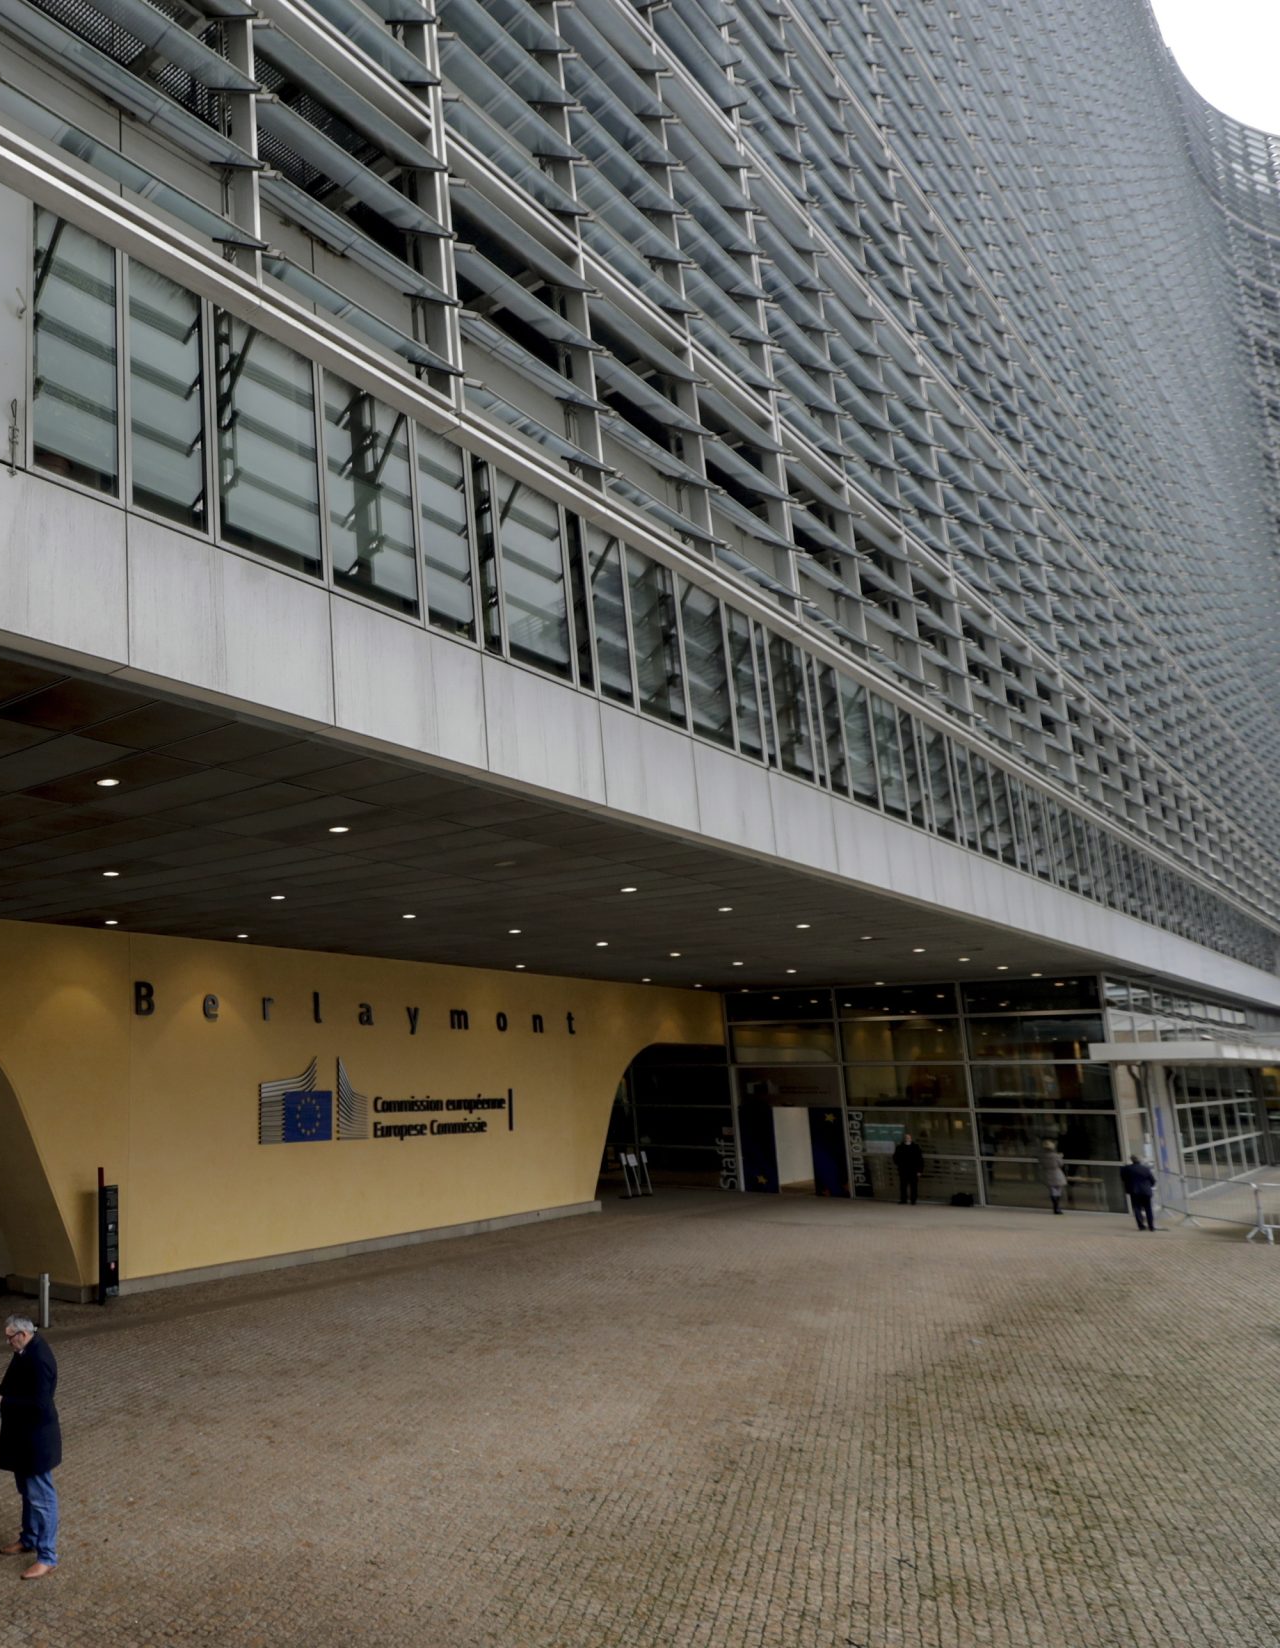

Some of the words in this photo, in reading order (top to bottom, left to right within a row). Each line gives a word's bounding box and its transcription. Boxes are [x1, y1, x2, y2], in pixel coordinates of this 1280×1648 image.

[133, 980, 577, 1035] Berlaymont
[372, 1120, 428, 1141] Europese
[429, 1117, 488, 1136] Commissie
[373, 1095, 444, 1114] Commission
[445, 1093, 507, 1114] européenne
[715, 1137, 738, 1191] Staff
[848, 1111, 872, 1187] Personnel
